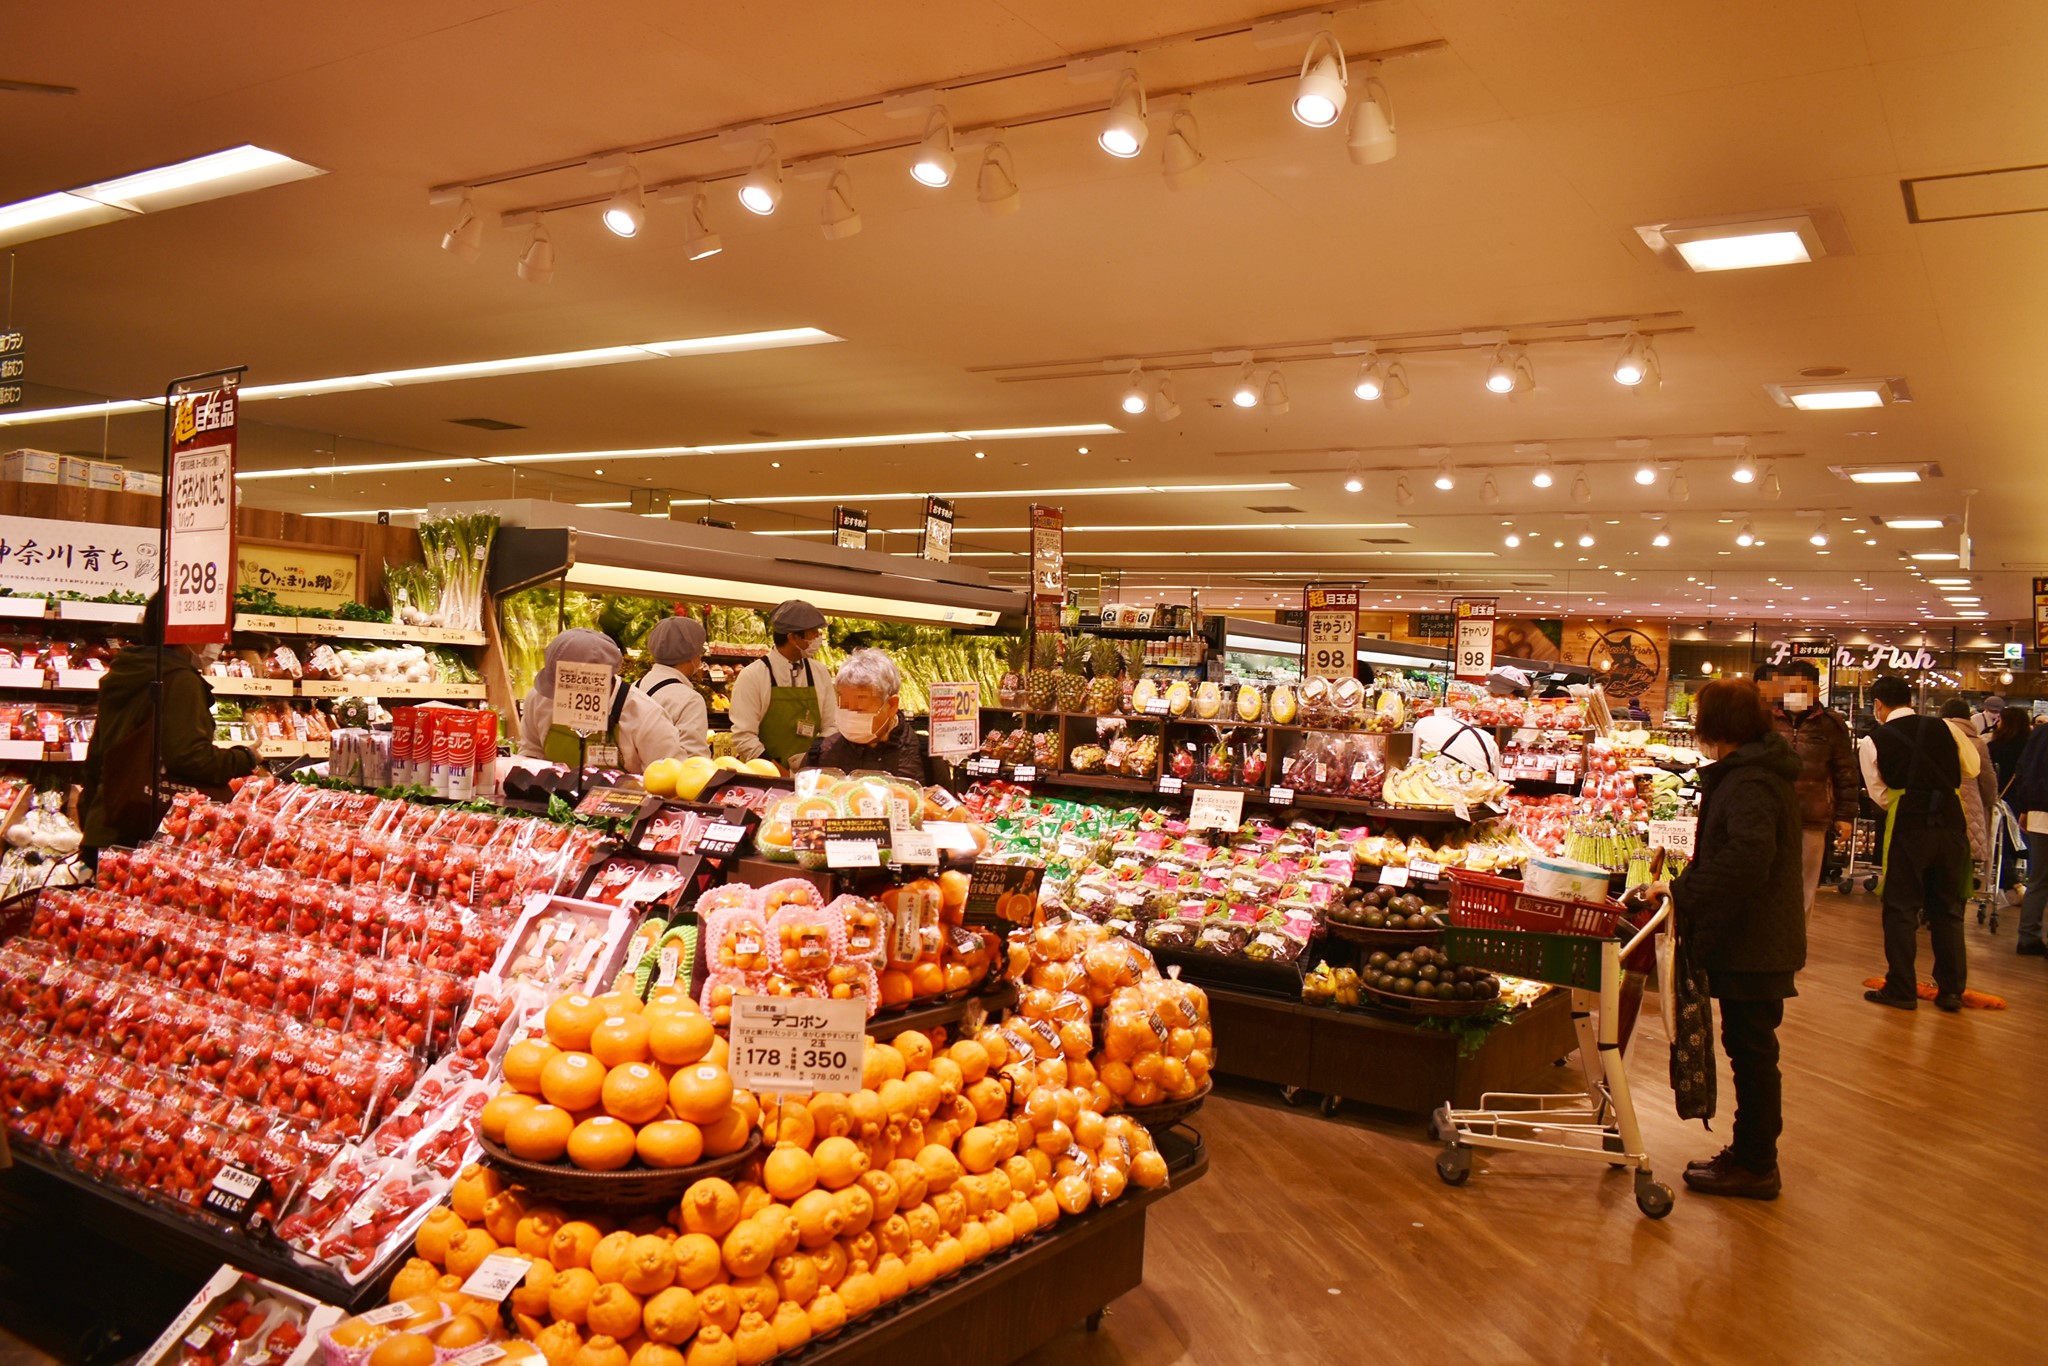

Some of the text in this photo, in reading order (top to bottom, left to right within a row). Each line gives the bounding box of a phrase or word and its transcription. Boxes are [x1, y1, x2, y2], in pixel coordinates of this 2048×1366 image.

[179, 562, 217, 595] 298
[259, 568, 332, 592] ひだまりの郷
[1309, 590, 1357, 608] 超目玉品
[1313, 620, 1352, 634] きゅうり
[1461, 625, 1490, 637] キャベツ
[1316, 650, 1346, 668] 98
[1464, 652, 1484, 667] 98
[1863, 642, 1937, 670] Fish
[560, 673, 606, 687] とちおとめいちご
[575, 693, 601, 712] 298
[956, 691, 971, 715] 20
[448, 737, 473, 749] ミルク
[959, 732, 973, 745] 380
[449, 767, 466, 777] MILK
[1668, 835, 1688, 845] 158
[917, 848, 932, 857] 498
[972, 871, 1007, 883] こだわり
[1534, 903, 1560, 914] ライフ
[810, 1039, 826, 1048] 2玉
[747, 1048, 781, 1065] 178
[803, 1050, 847, 1069] 350
[810, 1073, 841, 1081] 378.00
